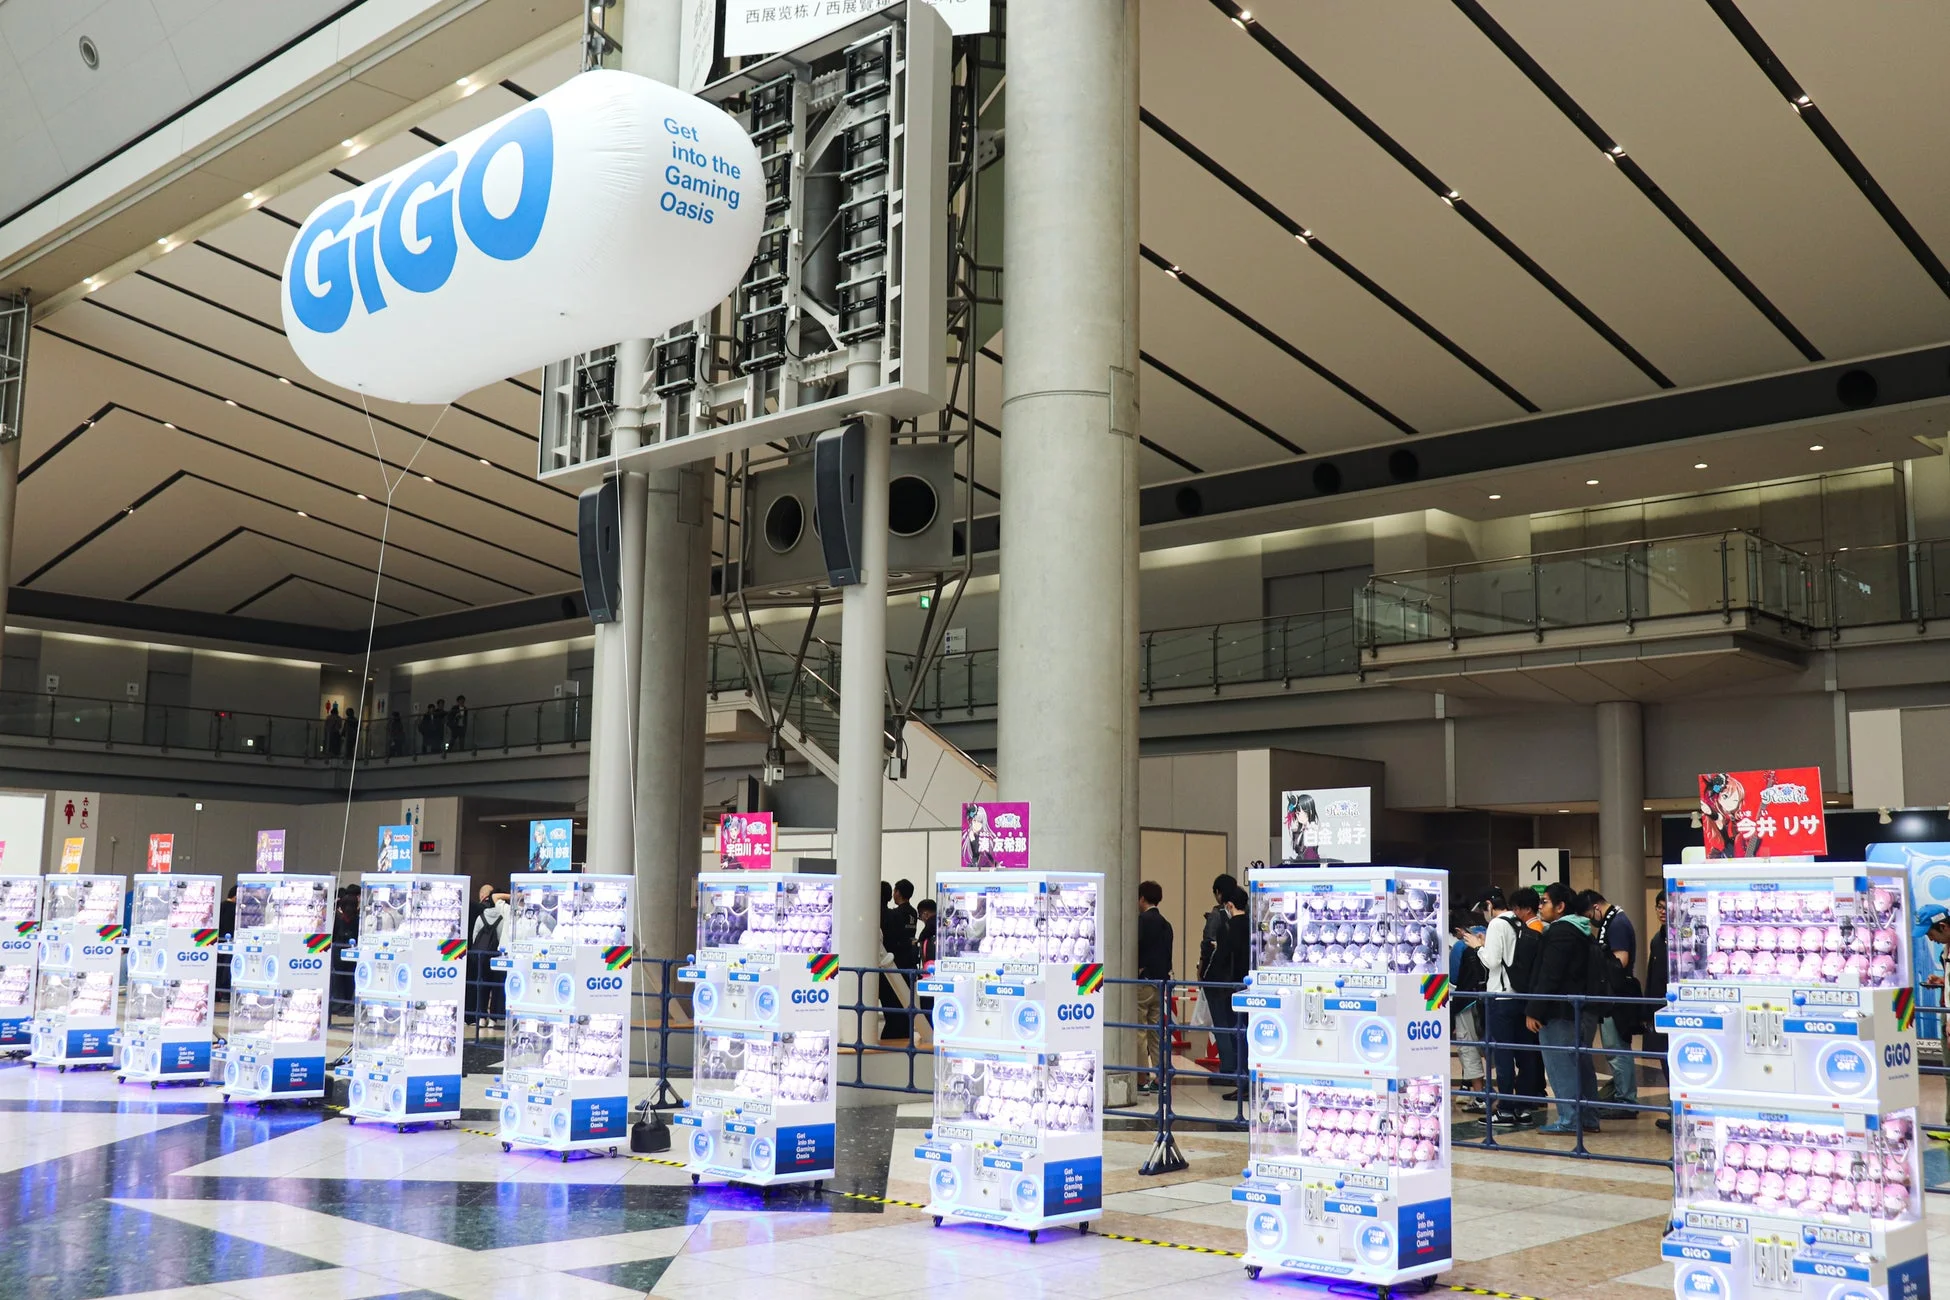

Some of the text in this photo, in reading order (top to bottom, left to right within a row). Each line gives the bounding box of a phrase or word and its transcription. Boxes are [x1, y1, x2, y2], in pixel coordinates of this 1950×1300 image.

[746, 4, 810, 24] 西展览栋
[664, 118, 699, 142] Get
[672, 141, 741, 179] into the
[665, 165, 740, 210] Gaming
[660, 191, 715, 224] Oasis
[290, 107, 554, 333] GiGO
[1736, 815, 1820, 838] 今井 リサ
[1304, 828, 1332, 846] 白金
[727, 842, 771, 857] 宇田川 あこ
[2, 941, 32, 950] GiGO
[83, 945, 114, 955] GiGO
[177, 951, 210, 962] GiGO
[289, 959, 323, 970] GiGO
[422, 967, 458, 979] GiGO
[586, 977, 623, 990] GiGO
[791, 989, 830, 1004] GiGO
[1246, 997, 1268, 1007] GiGO
[1338, 1000, 1362, 1010] GiGO
[1057, 1003, 1095, 1021] GiGO
[1674, 1016, 1704, 1028] GiGO
[1804, 1021, 1836, 1033] GiGO
[1407, 1020, 1442, 1041] GiGO
[1885, 1042, 1911, 1068] GiGO
[796, 1145, 816, 1153] Gaming
[1075, 1174, 1083, 1182] the
[1064, 1183, 1083, 1191] Gaming
[1064, 1191, 1078, 1199] Oasis
[1246, 1192, 1268, 1203] GiGO
[1339, 1203, 1362, 1214] GiGO
[1416, 1212, 1425, 1221] Get
[1416, 1229, 1435, 1240] Gaming
[1416, 1238, 1430, 1248] Oasis
[1682, 1247, 1712, 1260] GiGO
[1814, 1264, 1848, 1278] GiGO
